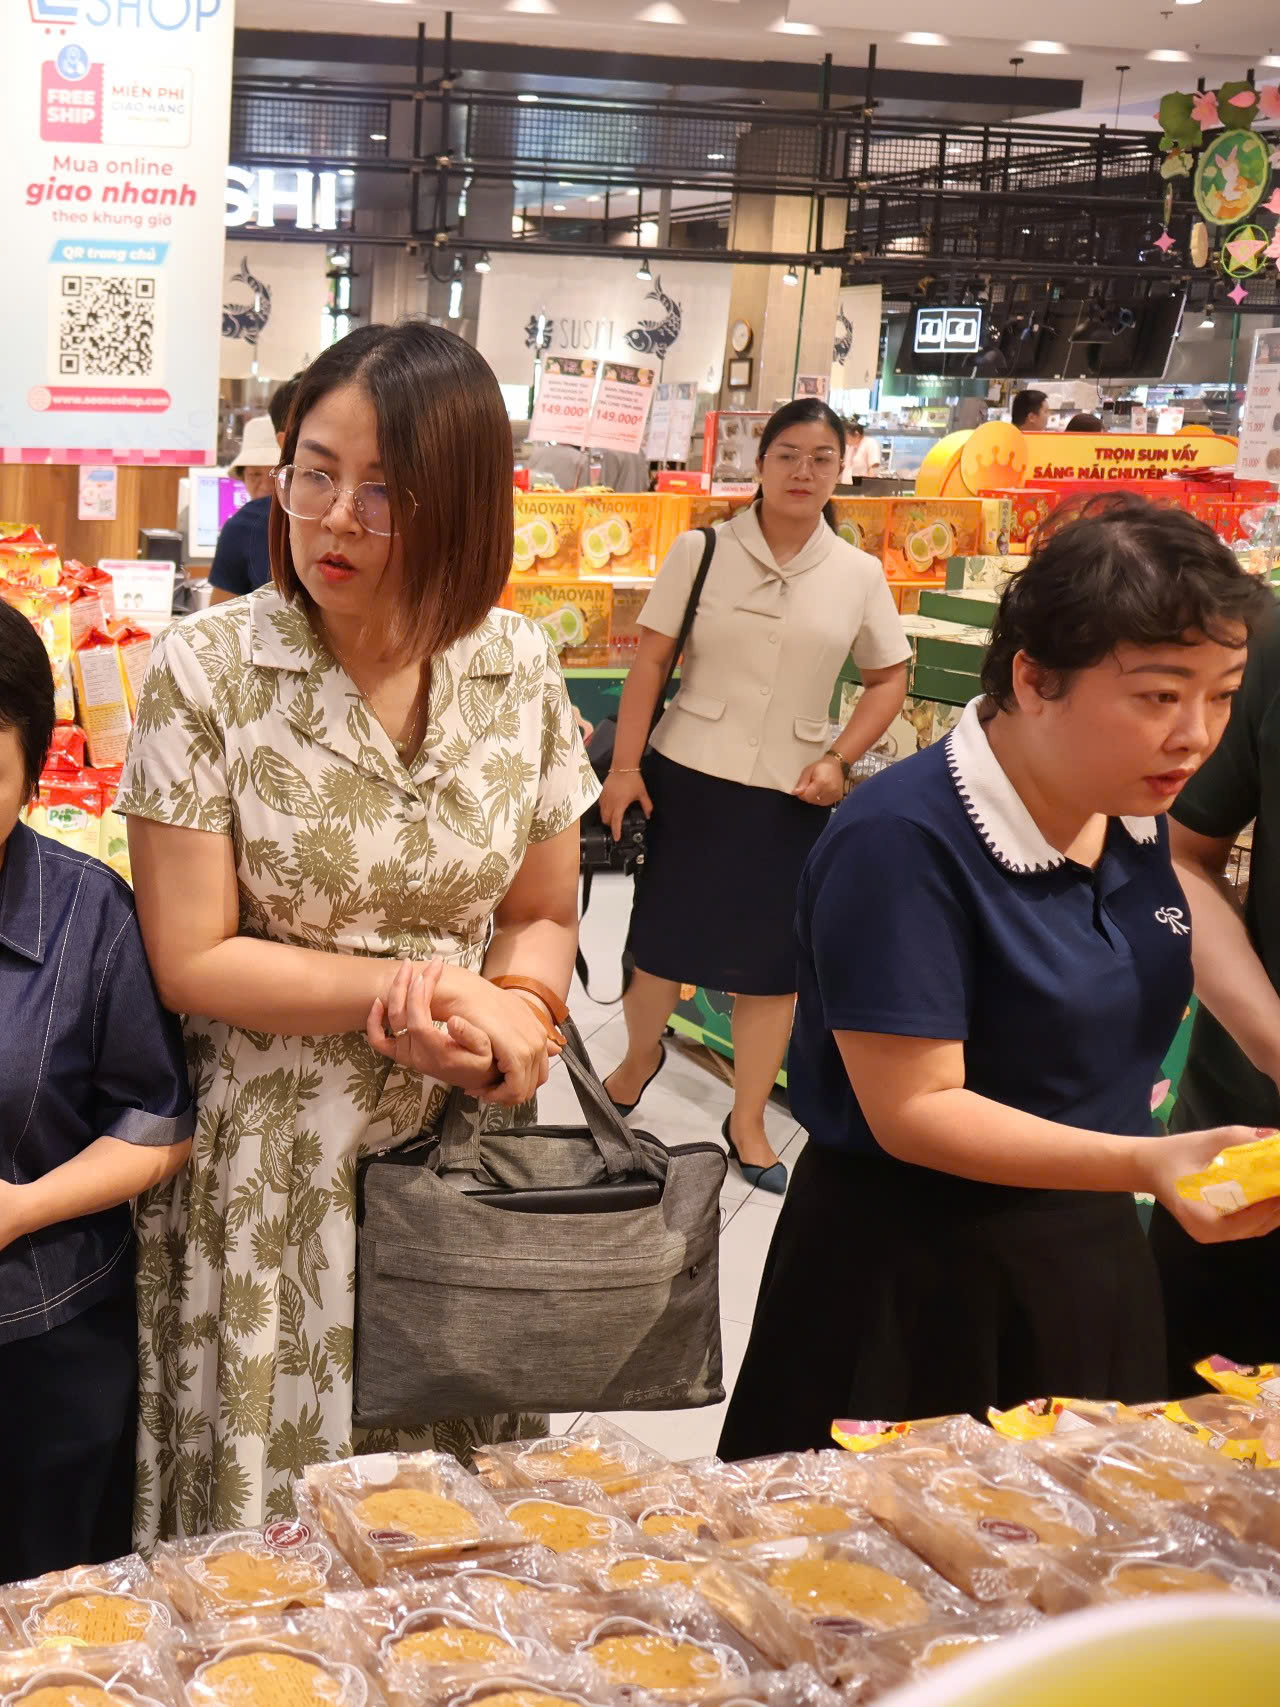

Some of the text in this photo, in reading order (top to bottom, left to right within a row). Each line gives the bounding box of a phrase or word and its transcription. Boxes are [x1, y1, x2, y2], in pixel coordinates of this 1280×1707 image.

[47, 89, 96, 105] FREE
[47, 106, 96, 124] SHIP
[53, 155, 173, 176] Mua online
[26, 176, 197, 206] giao nhanh
[224, 165, 337, 230] SHI
[52, 211, 88, 223] theo
[93, 212, 143, 228] khung
[62, 246, 85, 260] QR
[88, 247, 126, 262] trang
[1095, 448, 1136, 464] TRỌN
[1137, 449, 1169, 461] SUM
[1033, 462, 1074, 479] SÁNG
